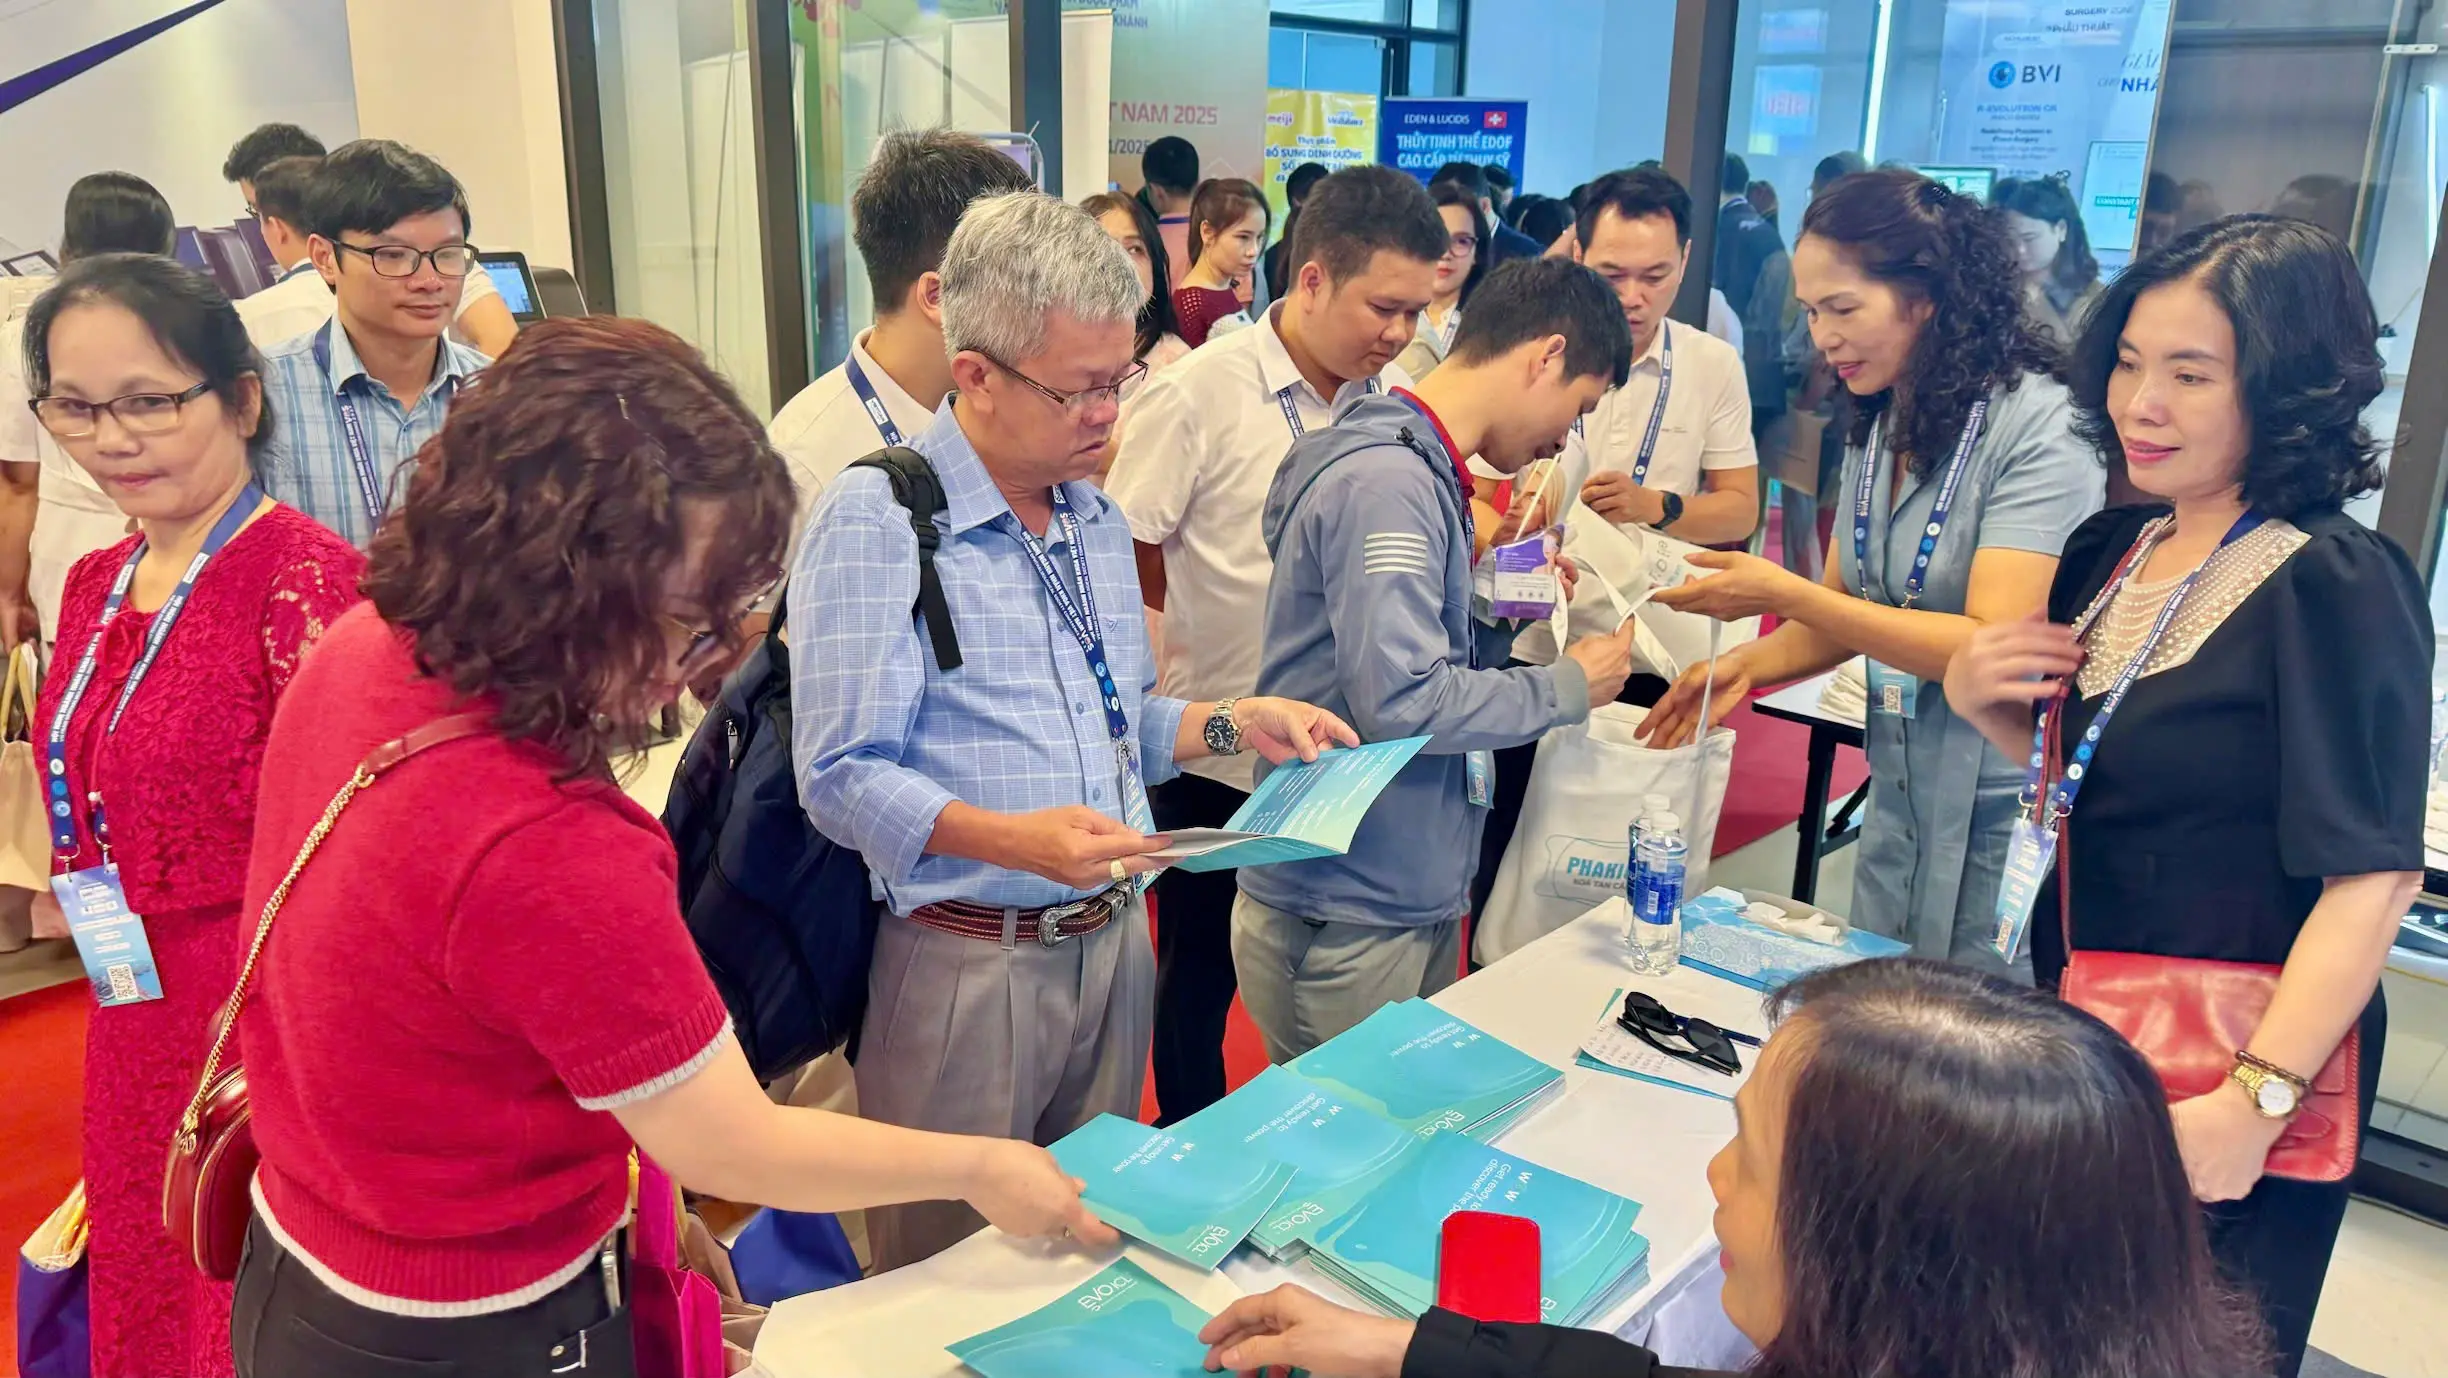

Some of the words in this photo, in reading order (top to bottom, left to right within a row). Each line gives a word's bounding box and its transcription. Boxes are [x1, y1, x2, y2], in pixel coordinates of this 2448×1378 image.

[2022, 64, 2062, 84] BVI
[1121, 103, 1169, 125] NAM
[1173, 104, 1219, 125] 2025
[1267, 112, 1293, 126] meiji
[1404, 114, 1428, 124] EDEN
[1429, 114, 1435, 124] &
[1436, 114, 1470, 125] LUCIDIS
[1430, 135, 1456, 149] TINH
[1481, 135, 1513, 149] EDOF
[1397, 152, 1421, 168] CAO
[1036, 553, 1053, 575] NGÀNH
[1048, 572, 1063, 591] NHÃN
[1057, 588, 1072, 606] KHOA
[1079, 629, 1097, 651] VOS
[1471, 1158, 1498, 1193] discover
[1476, 1178, 1498, 1203] ready
